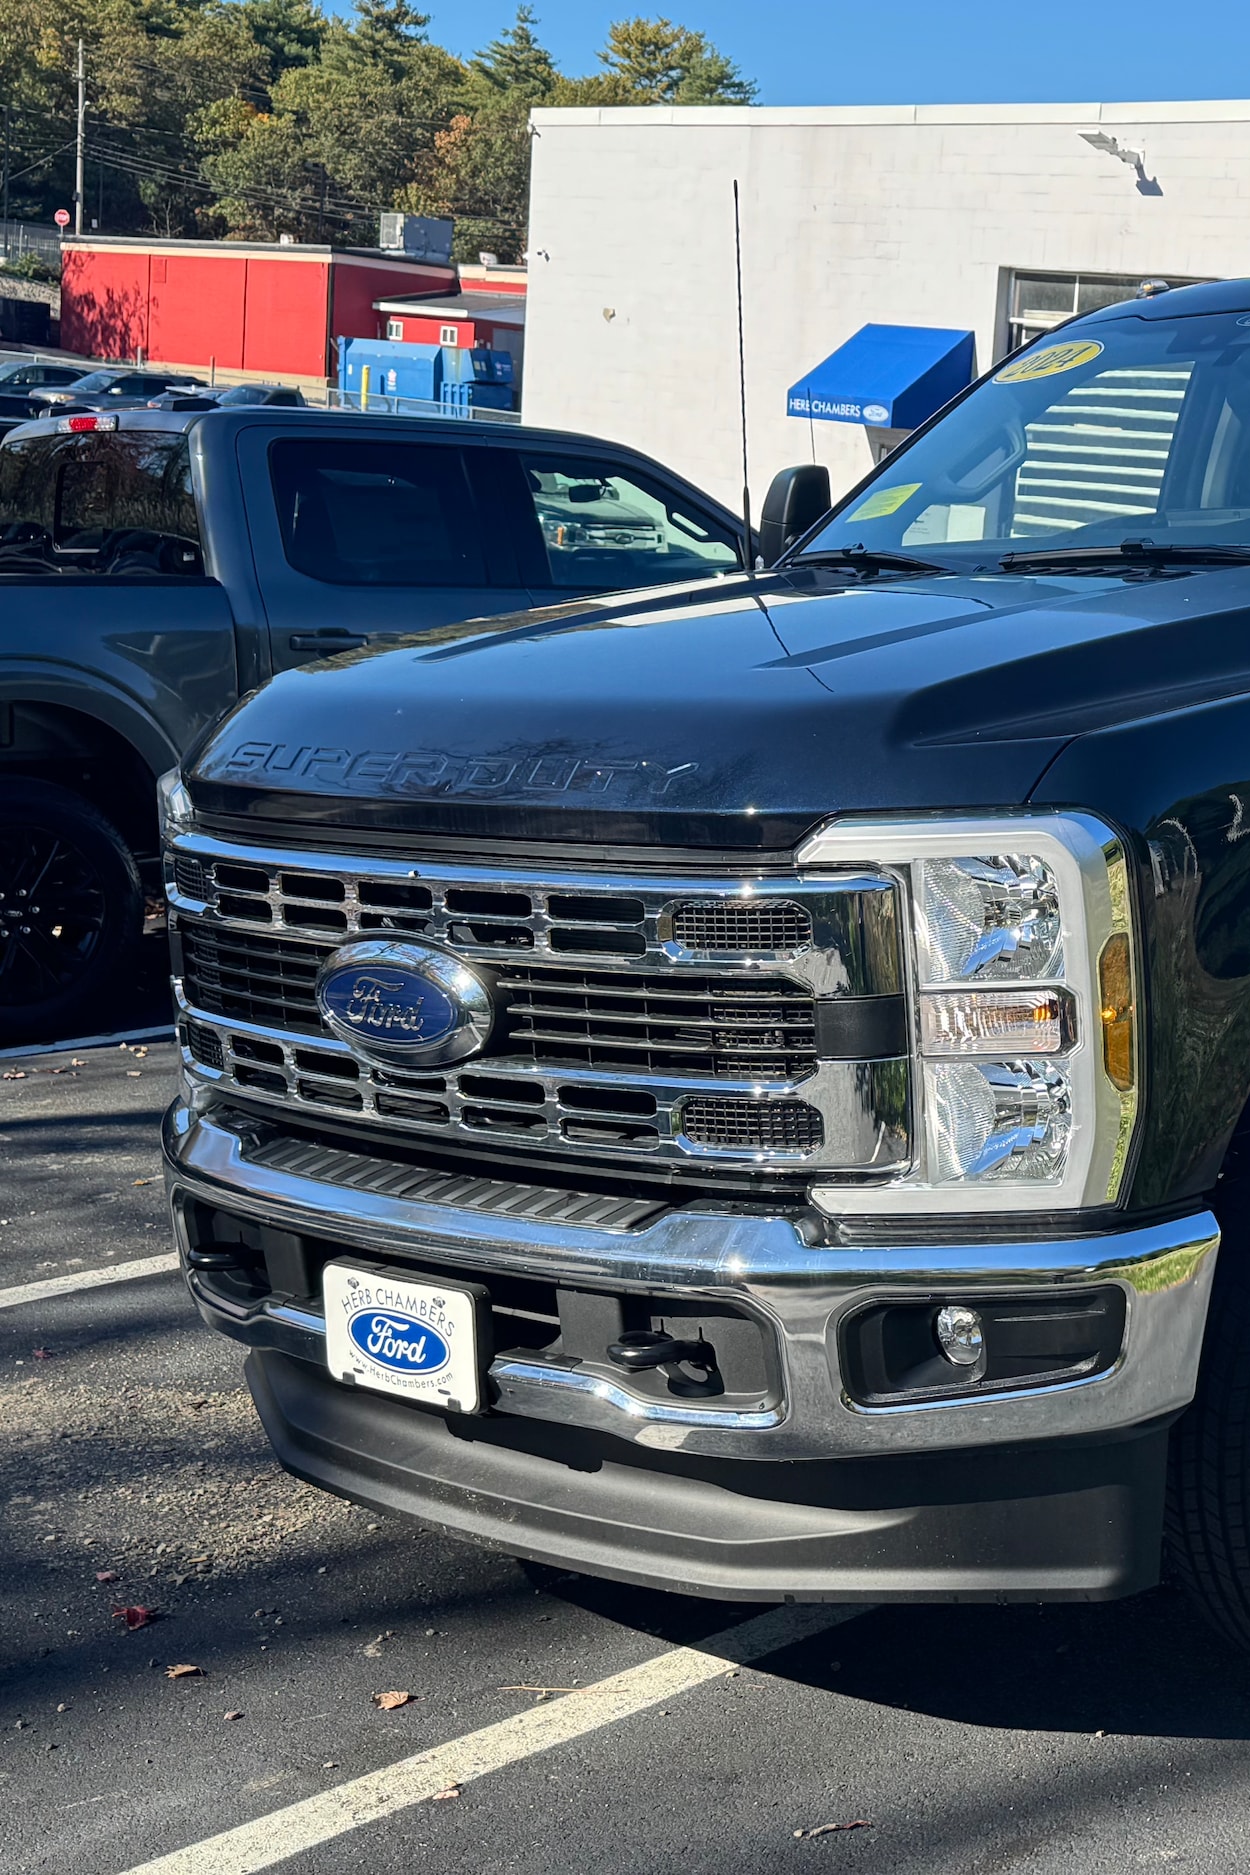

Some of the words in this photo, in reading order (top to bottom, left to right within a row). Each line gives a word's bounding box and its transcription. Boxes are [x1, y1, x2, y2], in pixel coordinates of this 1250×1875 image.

[1003, 345, 1092, 378] 2024
[811, 400, 861, 417] CHAMBERS
[225, 741, 448, 787] SUPER
[452, 756, 699, 793] DUTY
[346, 976, 424, 1031] Ford
[341, 1287, 372, 1314] HERB
[375, 1288, 455, 1337] CHAMBERS
[367, 1316, 426, 1363] Ford
[349, 1349, 454, 1388] www.HerbChambers.com
